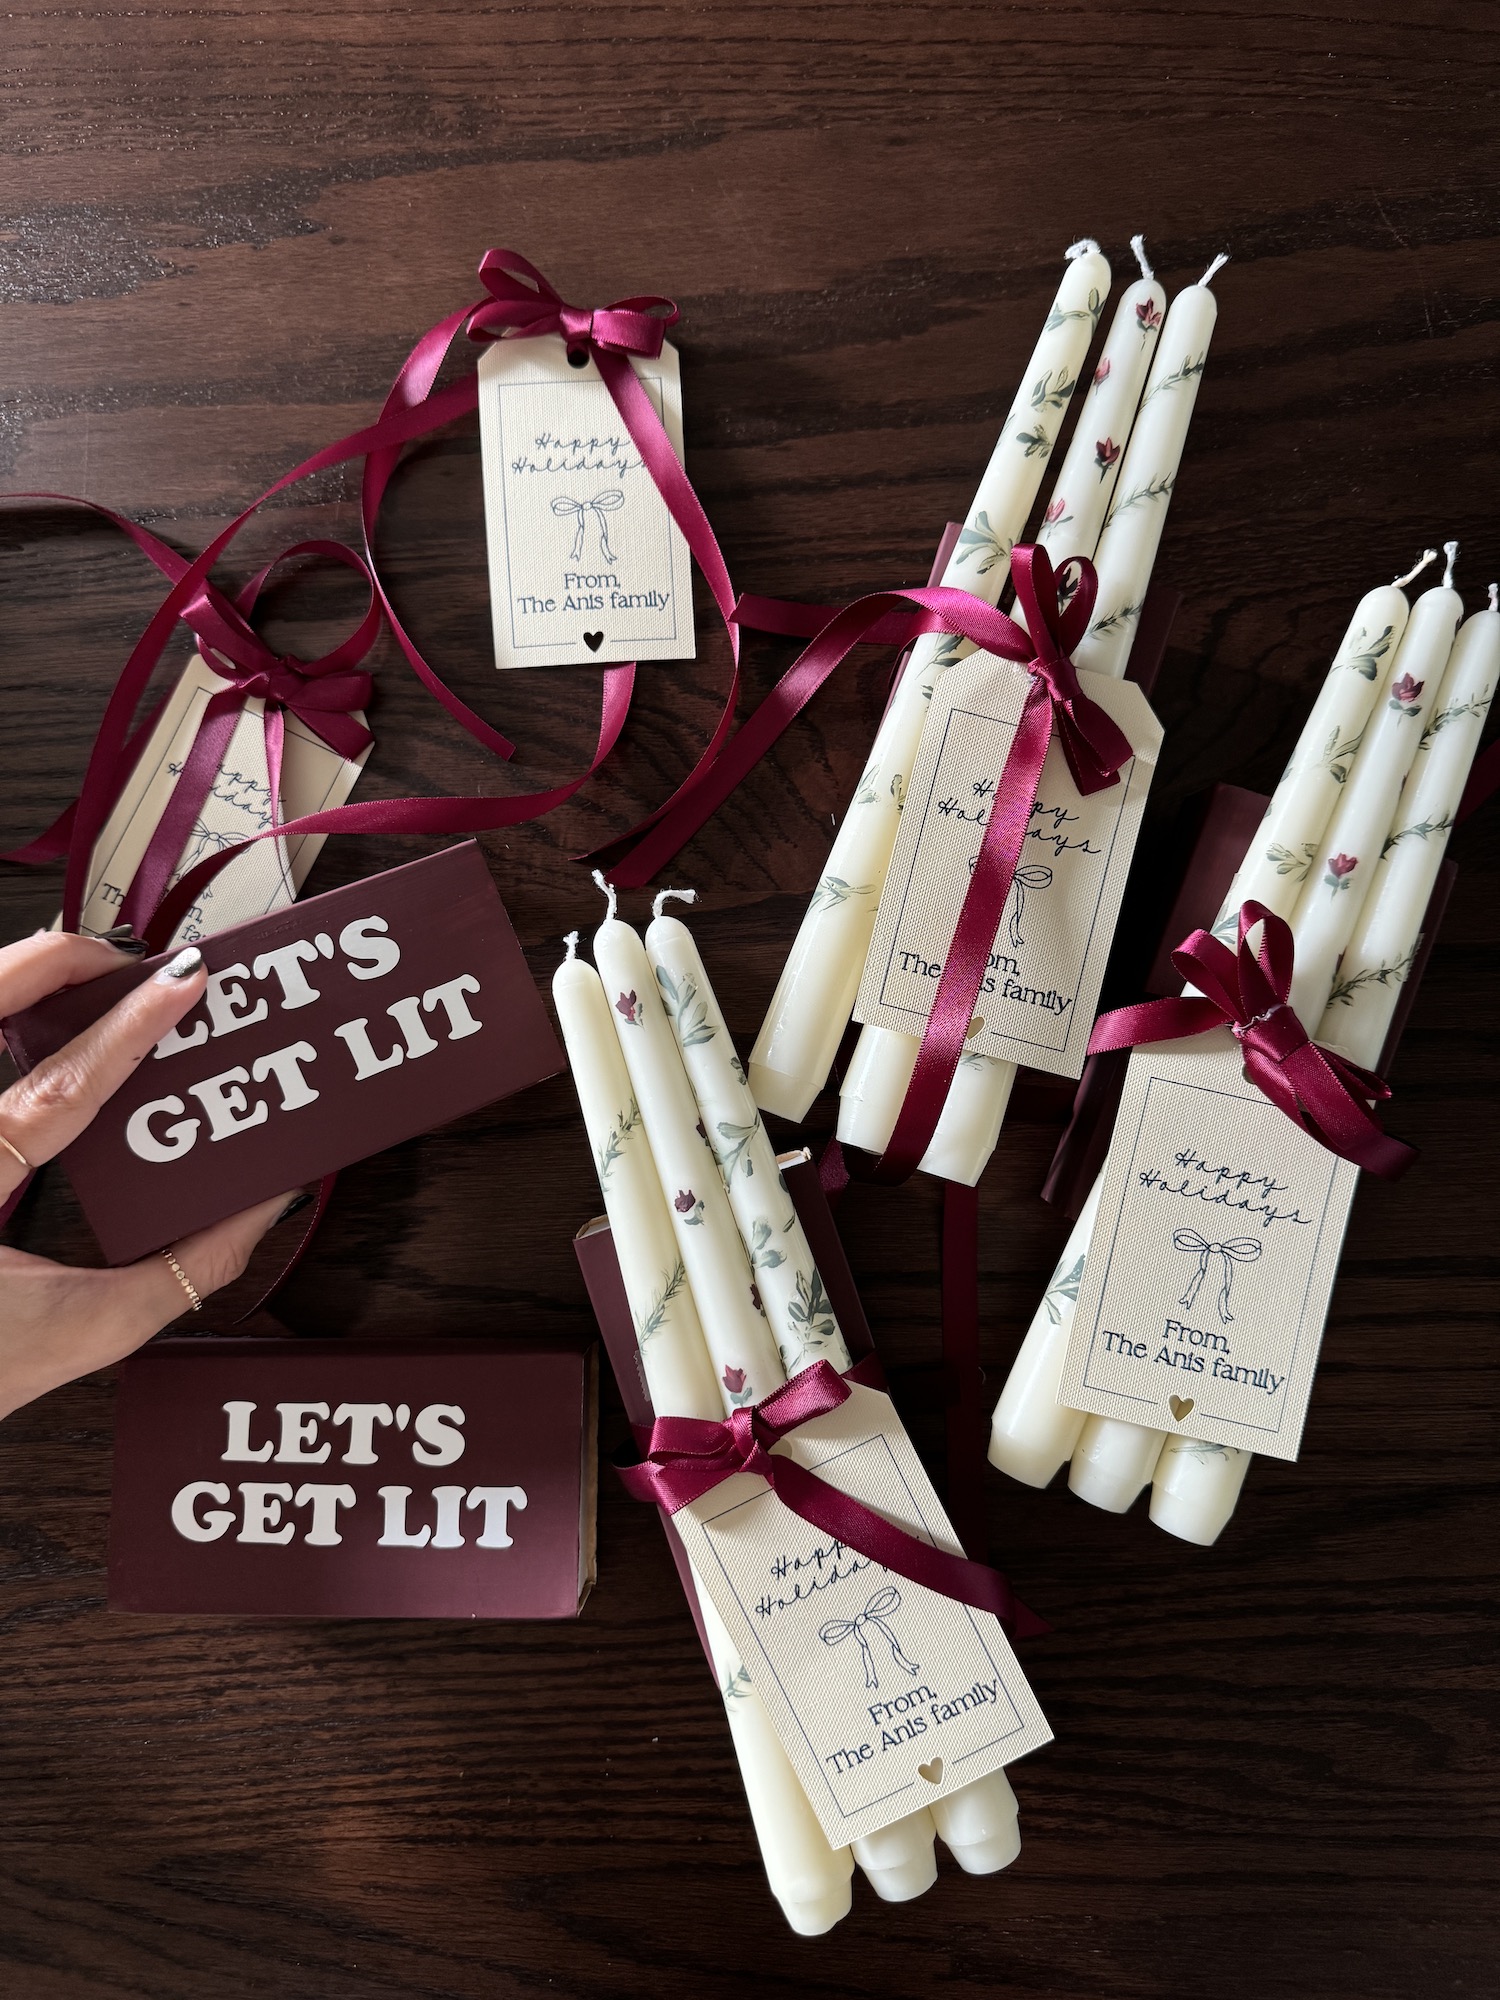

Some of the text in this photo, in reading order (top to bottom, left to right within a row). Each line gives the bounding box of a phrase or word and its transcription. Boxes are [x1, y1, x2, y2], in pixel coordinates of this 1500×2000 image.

[511, 456, 646, 479] Holiday
[535, 432, 631, 456] Happy
[517, 589, 670, 614] The Anis family
[564, 572, 622, 590] From,
[938, 797, 1102, 857] Holays
[972, 778, 1080, 829] Hpy
[103, 882, 126, 908] Th
[899, 951, 942, 979] The
[1001, 978, 1073, 1017] family
[125, 973, 484, 1164] GET LIT
[1174, 1148, 1289, 1196] Happy
[1139, 1168, 1313, 1228] Holidays
[1162, 1318, 1231, 1355] From,
[1102, 1329, 1286, 1396] The Anis family
[219, 1400, 467, 1467] LET'S
[170, 1480, 529, 1550] GET LIT
[770, 1539, 849, 1581] Happ
[755, 1558, 889, 1620] Holida
[825, 1677, 999, 1775] The Anis family
[866, 1684, 938, 1727] From,
